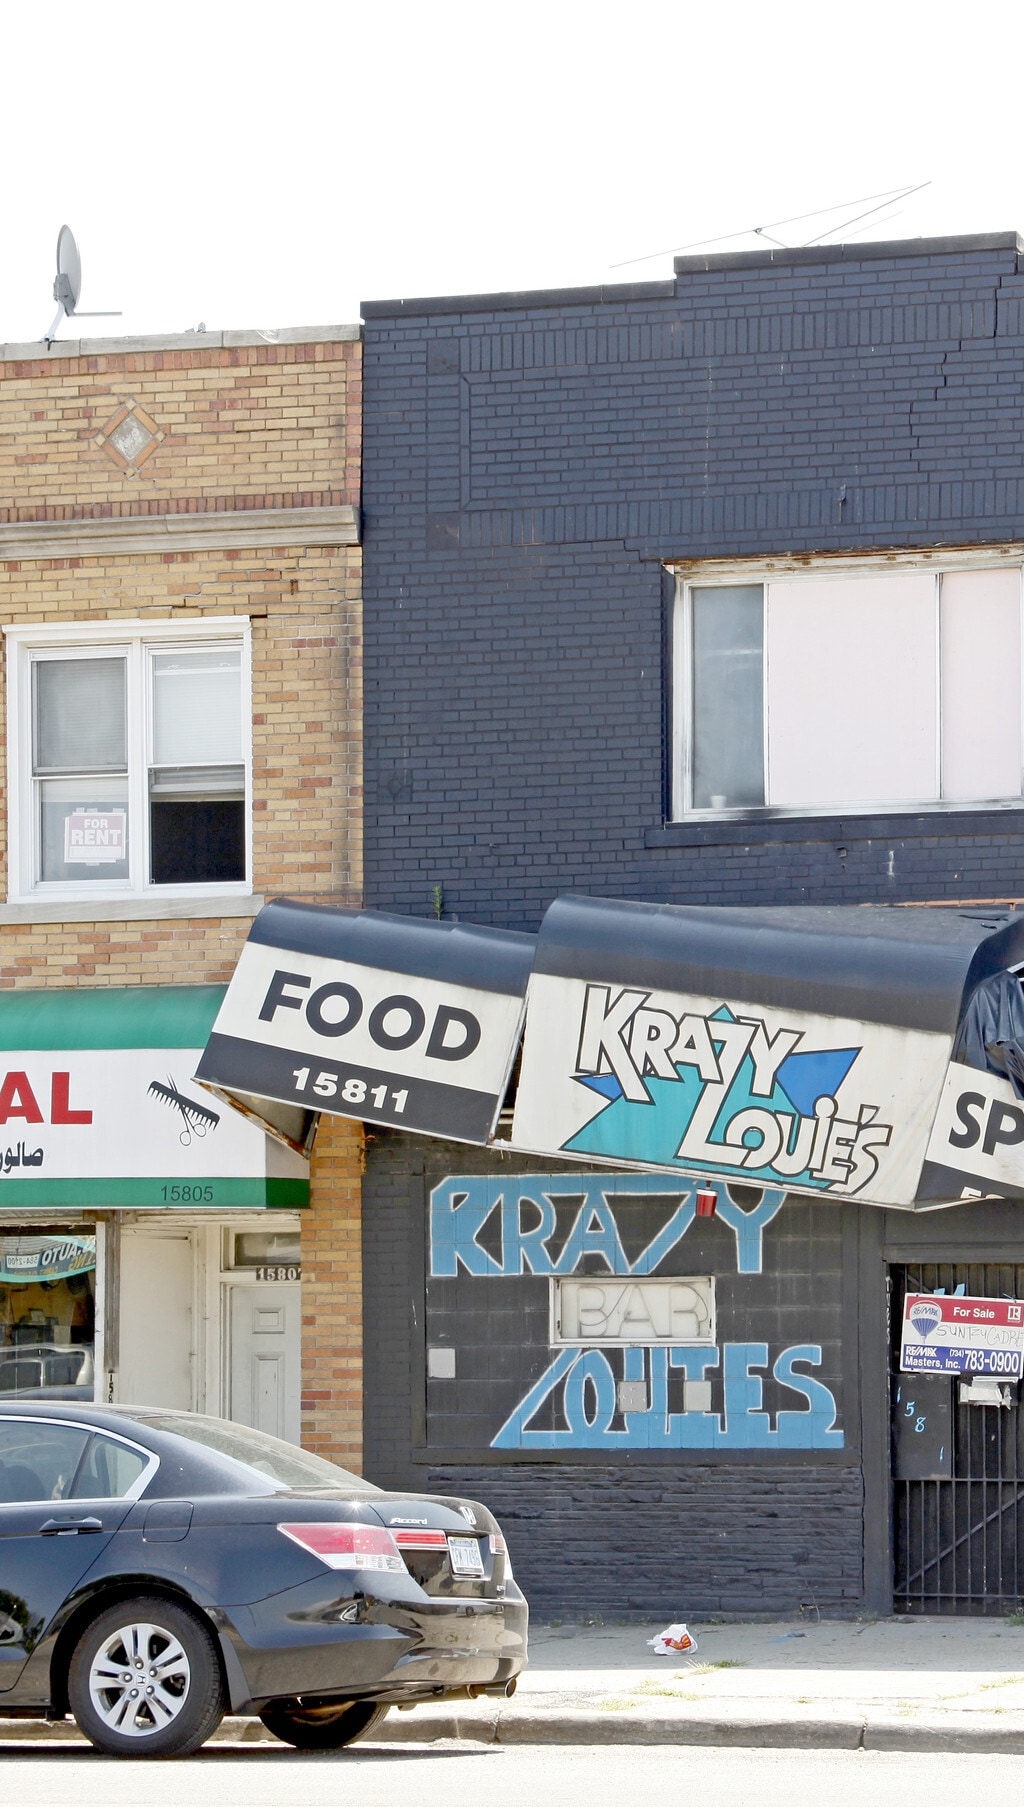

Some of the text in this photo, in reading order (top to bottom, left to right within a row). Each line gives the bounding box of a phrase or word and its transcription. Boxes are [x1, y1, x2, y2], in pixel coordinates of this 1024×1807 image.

[84, 818, 108, 829] FOR
[71, 829, 121, 845] RENT
[258, 969, 482, 1062] FOOD
[575, 983, 806, 1106] KRAZY
[292, 1066, 409, 1113] 15811
[160, 1185, 214, 1202] 15805
[430, 1173, 788, 1277] KRAZY
[577, 1284, 708, 1338] BAR
[953, 1306, 995, 1319] For Sale
[904, 1356, 961, 1369] Masters, Inc.
[905, 1345, 1019, 1373] RE/MAX (734) 783-0900
[389, 1516, 428, 1525] Accord
